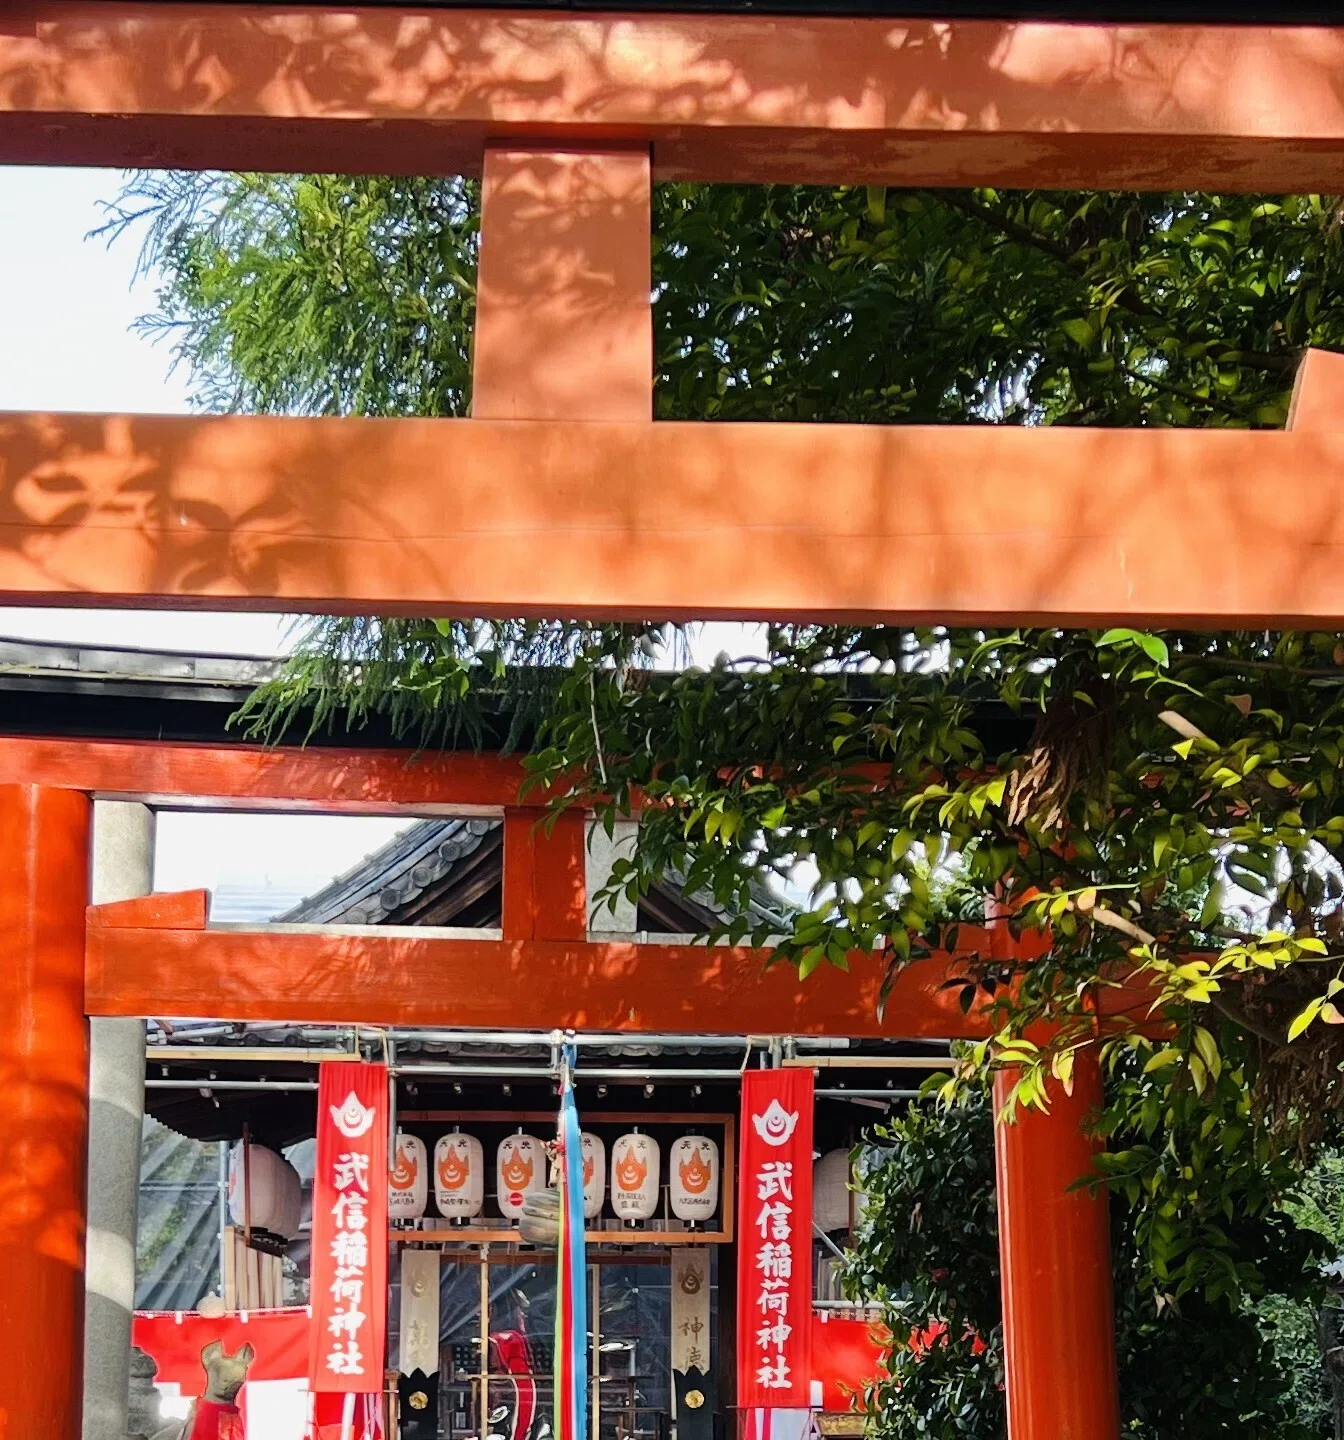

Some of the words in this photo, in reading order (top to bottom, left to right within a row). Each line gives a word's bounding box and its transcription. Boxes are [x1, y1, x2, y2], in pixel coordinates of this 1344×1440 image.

[326, 1152, 369, 1375] 武信稲荷神社
[755, 1161, 793, 1389] 武信稲荷神社
